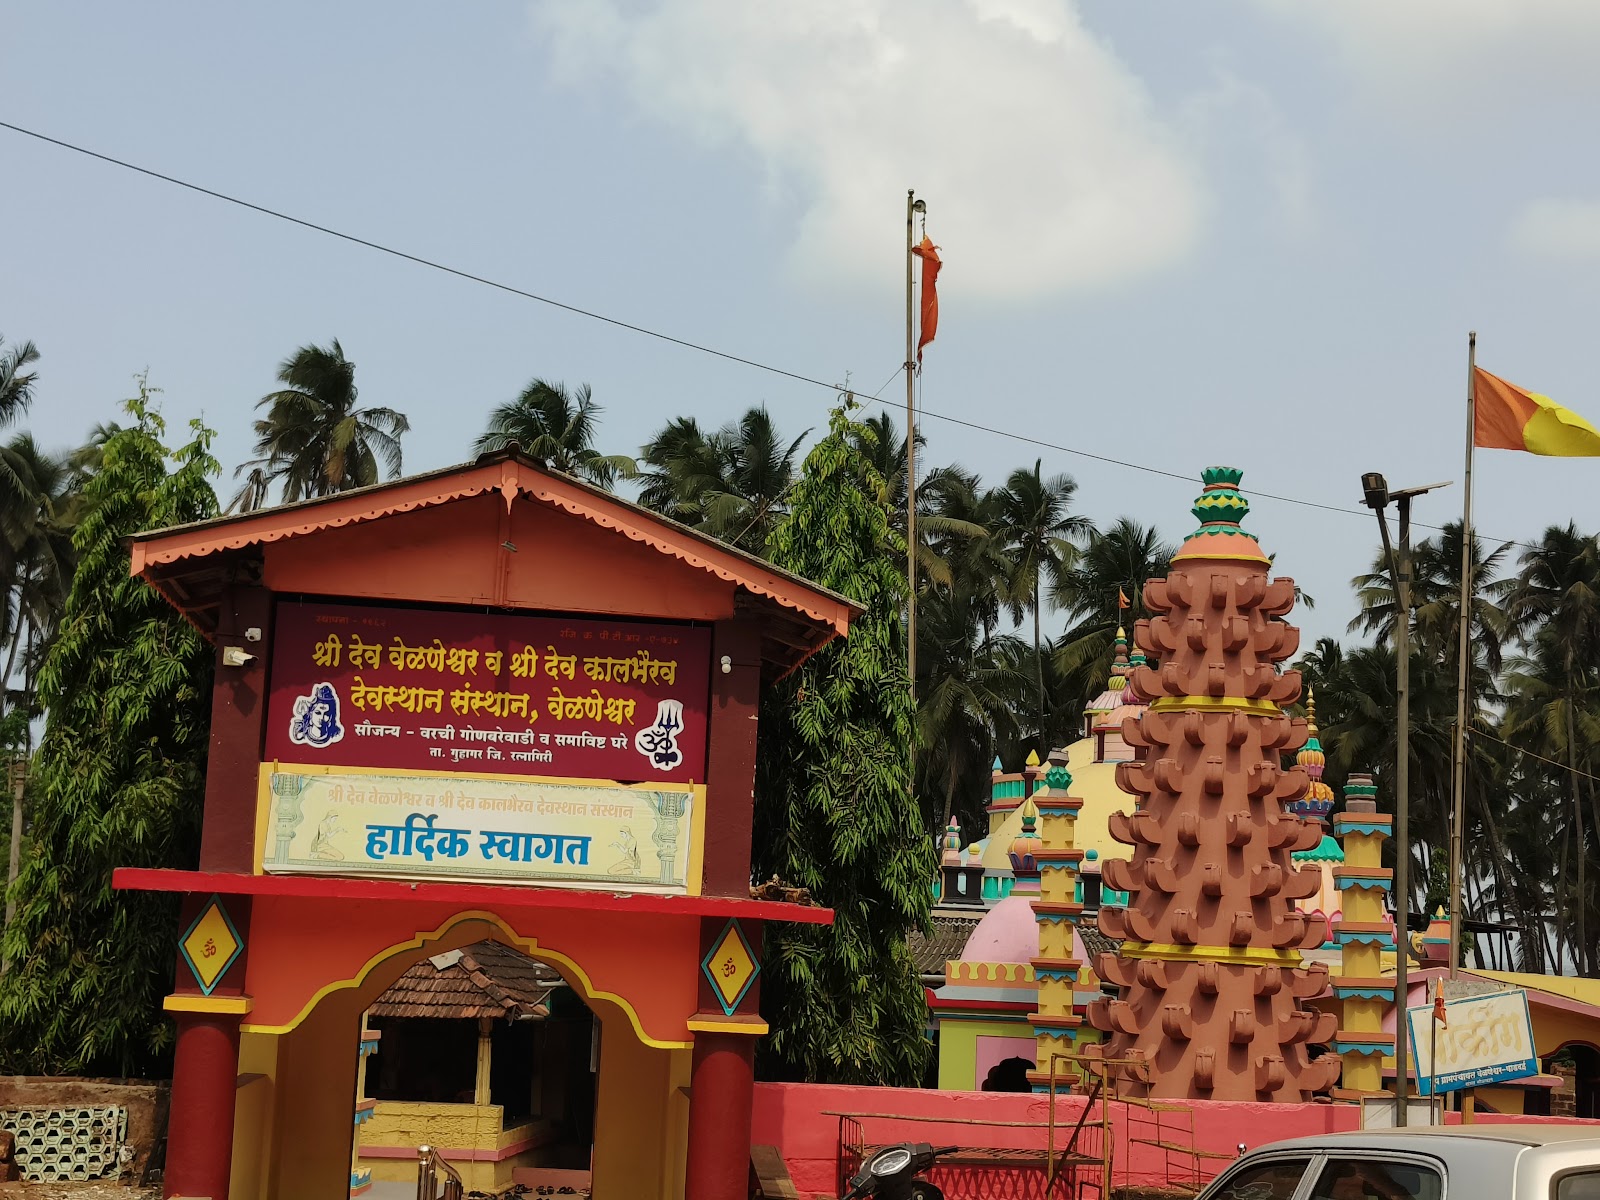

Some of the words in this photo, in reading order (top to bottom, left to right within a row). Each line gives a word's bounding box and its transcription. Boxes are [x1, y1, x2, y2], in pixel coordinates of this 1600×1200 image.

[312, 633, 342, 667] श्री
[349, 634, 382, 670] देव
[389, 636, 479, 676] वेळणेश्वर
[485, 650, 503, 676] व
[509, 645, 538, 678] श्री
[544, 645, 577, 681] देव
[583, 650, 678, 686] कालभैरव
[351, 675, 444, 714] देवस्थान
[450, 682, 539, 724] संस्थान,
[547, 687, 636, 725] वेळणेश्वर
[354, 719, 401, 738] सौजन्य
[420, 724, 455, 740] वरची
[539, 733, 550, 746] व
[554, 731, 607, 749] समाविष्ट
[610, 733, 628, 750] घरे
[450, 748, 483, 763] गुहागर
[511, 750, 553, 763] रत्नागिरी
[328, 784, 345, 804] श्री
[347, 785, 365, 806] देव
[369, 786, 422, 807] वेळणेश्वर
[426, 794, 436, 808] व
[438, 789, 454, 809] श्री
[457, 790, 475, 811] देव
[478, 794, 534, 813] कालभैरव
[537, 795, 587, 816] देवस्थान
[591, 799, 634, 818] संस्थान
[365, 812, 472, 862] हार्दिक
[479, 830, 592, 866] स्वागत
